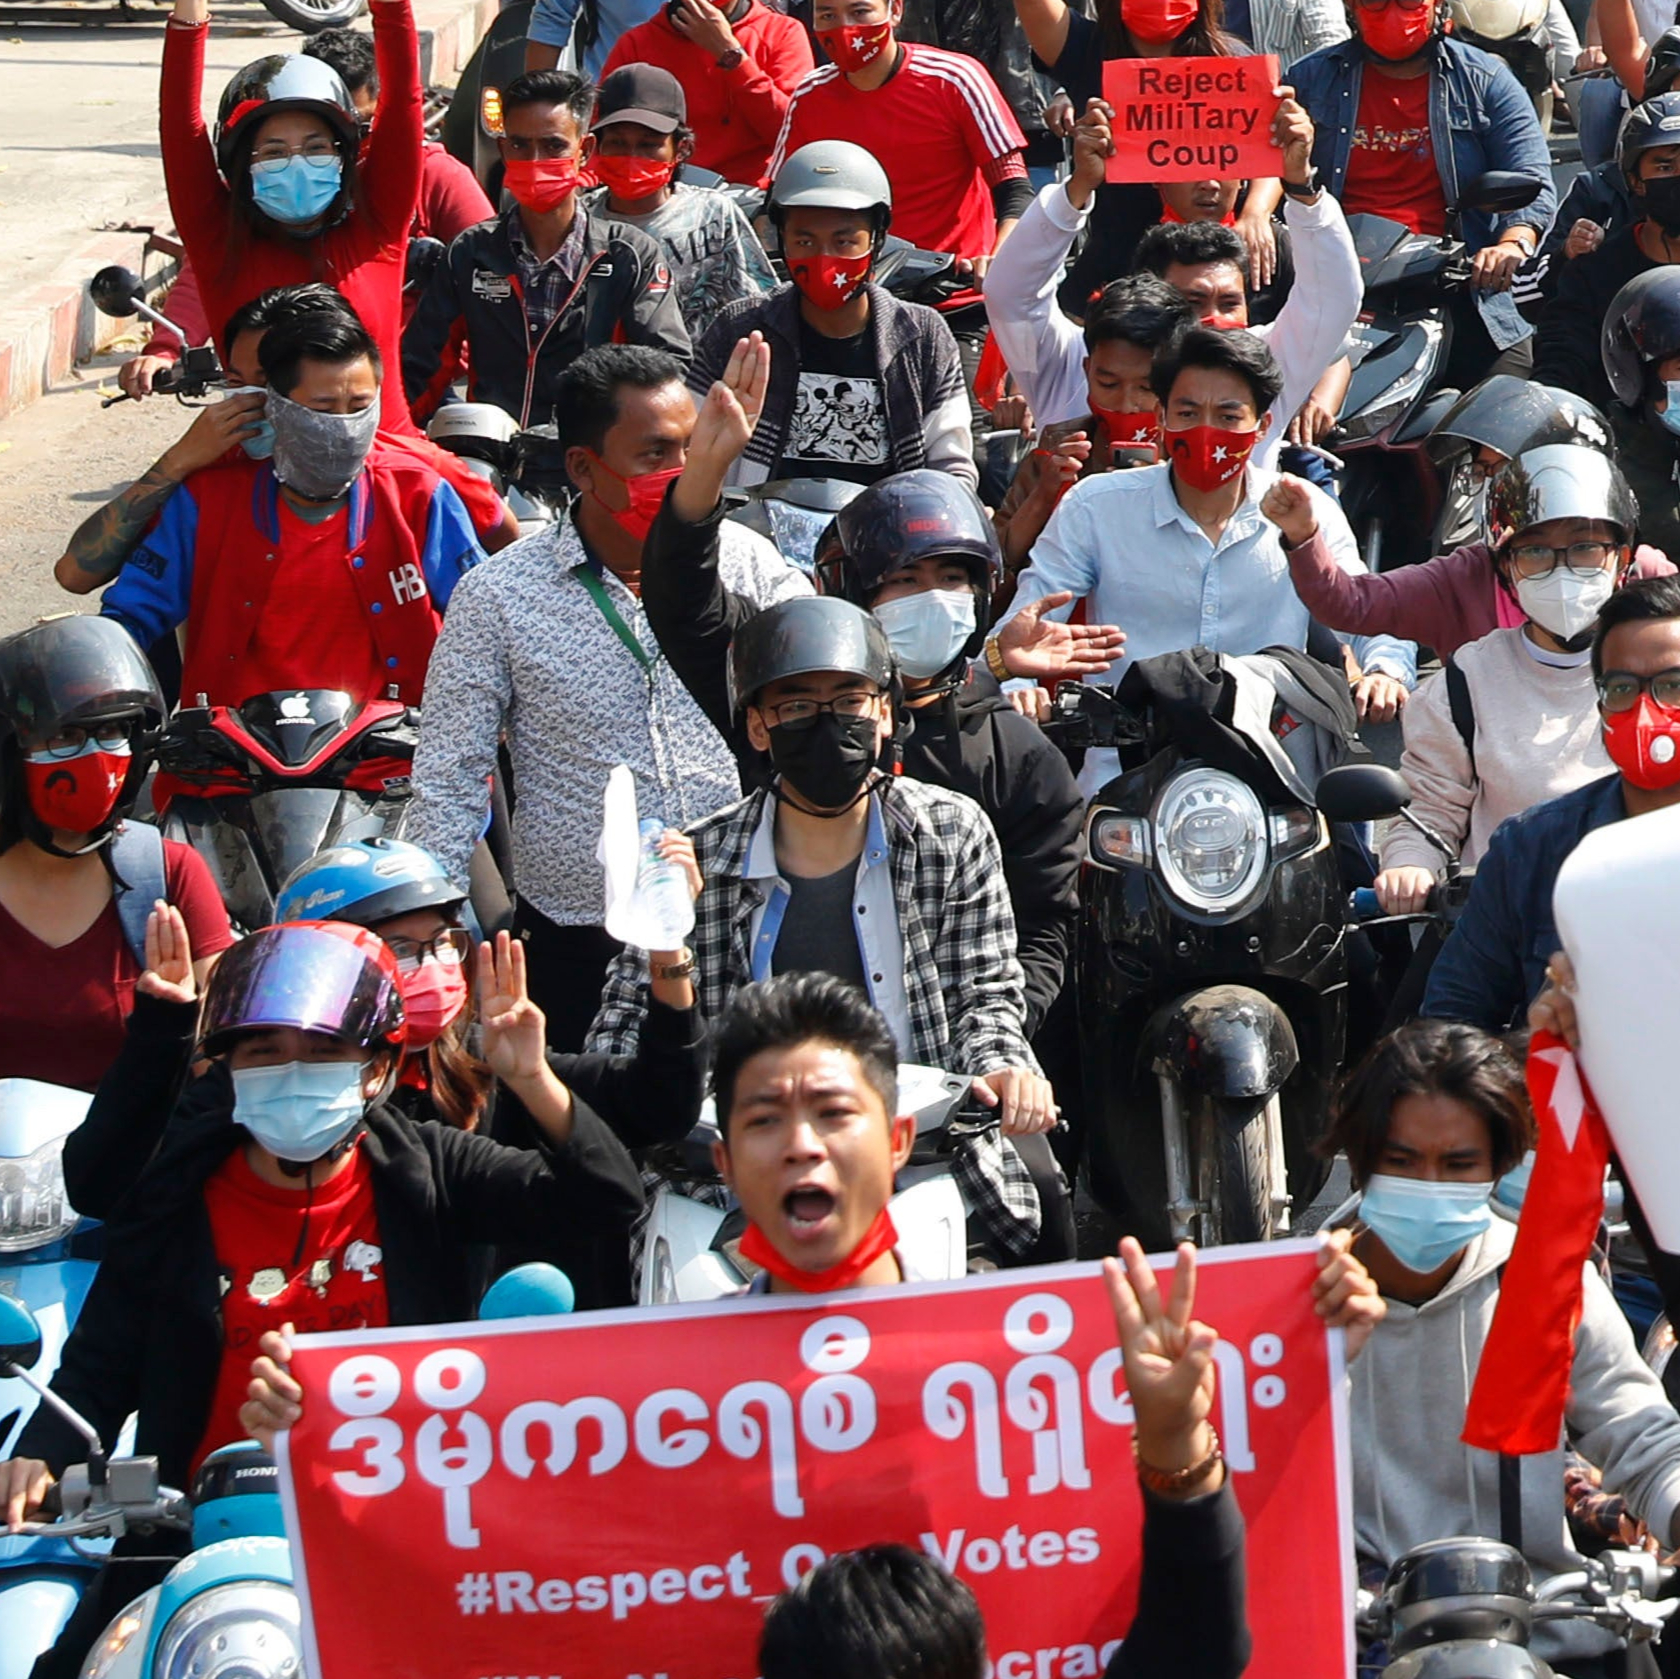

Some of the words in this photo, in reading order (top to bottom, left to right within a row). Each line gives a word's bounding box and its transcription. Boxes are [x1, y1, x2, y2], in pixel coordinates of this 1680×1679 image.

[862, 45, 880, 62] NLD
[1138, 66, 1247, 100] Reject
[1125, 101, 1260, 135] MiliTary
[1146, 139, 1239, 171] Coup
[1220, 463, 1241, 481] NLD
[275, 716, 317, 726] HONDA
[326, 1315, 878, 1551] ဒီမိုကရေစီ
[234, 1466, 279, 1479] HON
